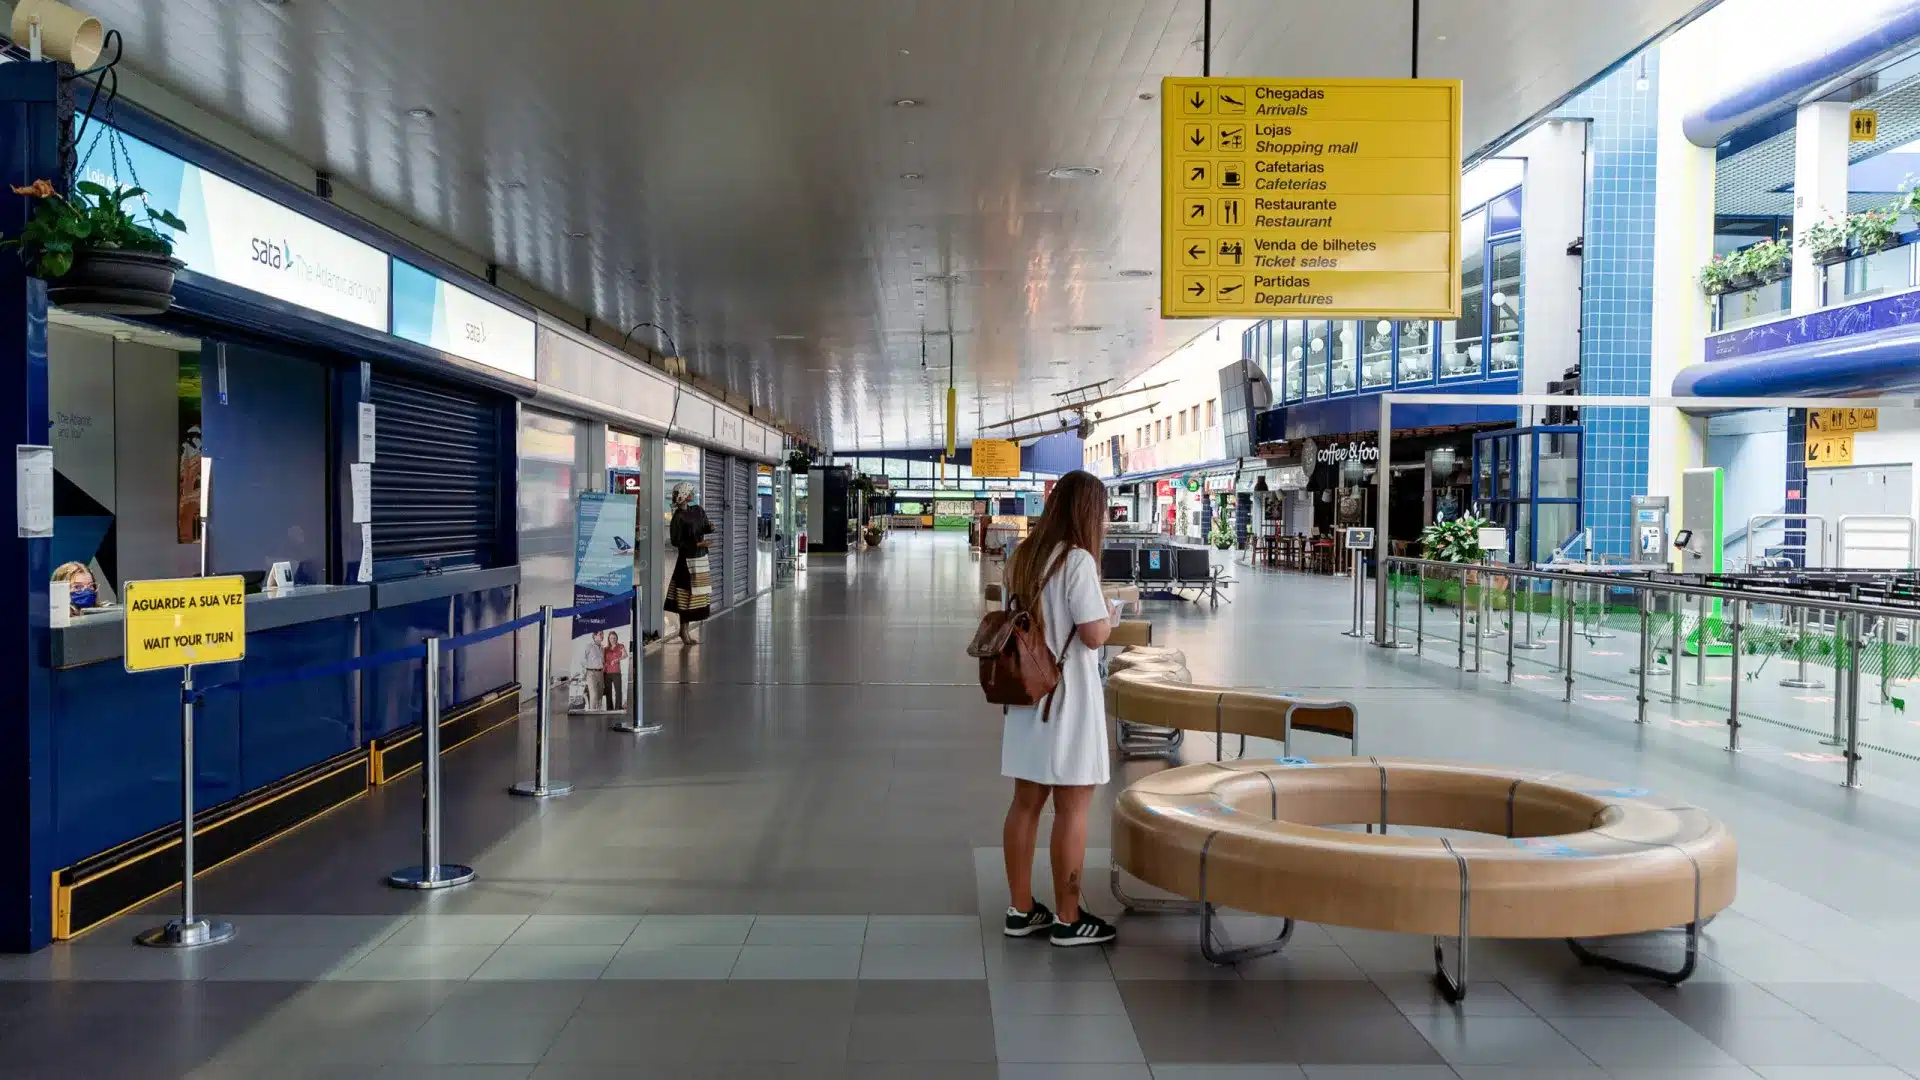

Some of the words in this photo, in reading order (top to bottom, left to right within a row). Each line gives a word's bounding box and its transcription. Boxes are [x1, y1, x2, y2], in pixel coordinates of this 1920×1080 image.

[1255, 87, 1325, 102] Chegadas
[1255, 104, 1308, 117] Arrivals
[1255, 123, 1292, 139] Lojas
[1255, 140, 1324, 157] Shopping
[1328, 141, 1358, 155] mall
[1254, 160, 1324, 174] Cafetarias
[1254, 177, 1328, 191] Cafeterias
[1254, 197, 1337, 211] Restaurante
[1254, 214, 1332, 228] Restaurant
[1254, 238, 1296, 252] Venda
[1301, 238, 1318, 252] de
[1323, 238, 1377, 252] bilhetes
[251, 237, 281, 270] sata
[1253, 255, 1296, 268] Ticket
[1300, 255, 1338, 268] sales
[1253, 274, 1310, 288] Partidas
[1253, 292, 1333, 307] Departures
[1317, 442, 1348, 465] coffee
[1348, 441, 1358, 459] &
[132, 597, 185, 611] AGUARDE
[188, 596, 197, 608] A
[199, 595, 220, 607] SUA
[223, 593, 242, 605] VEZ
[143, 637, 171, 650] WAIT
[174, 635, 202, 647] YOUR
[205, 631, 233, 644] TURN
